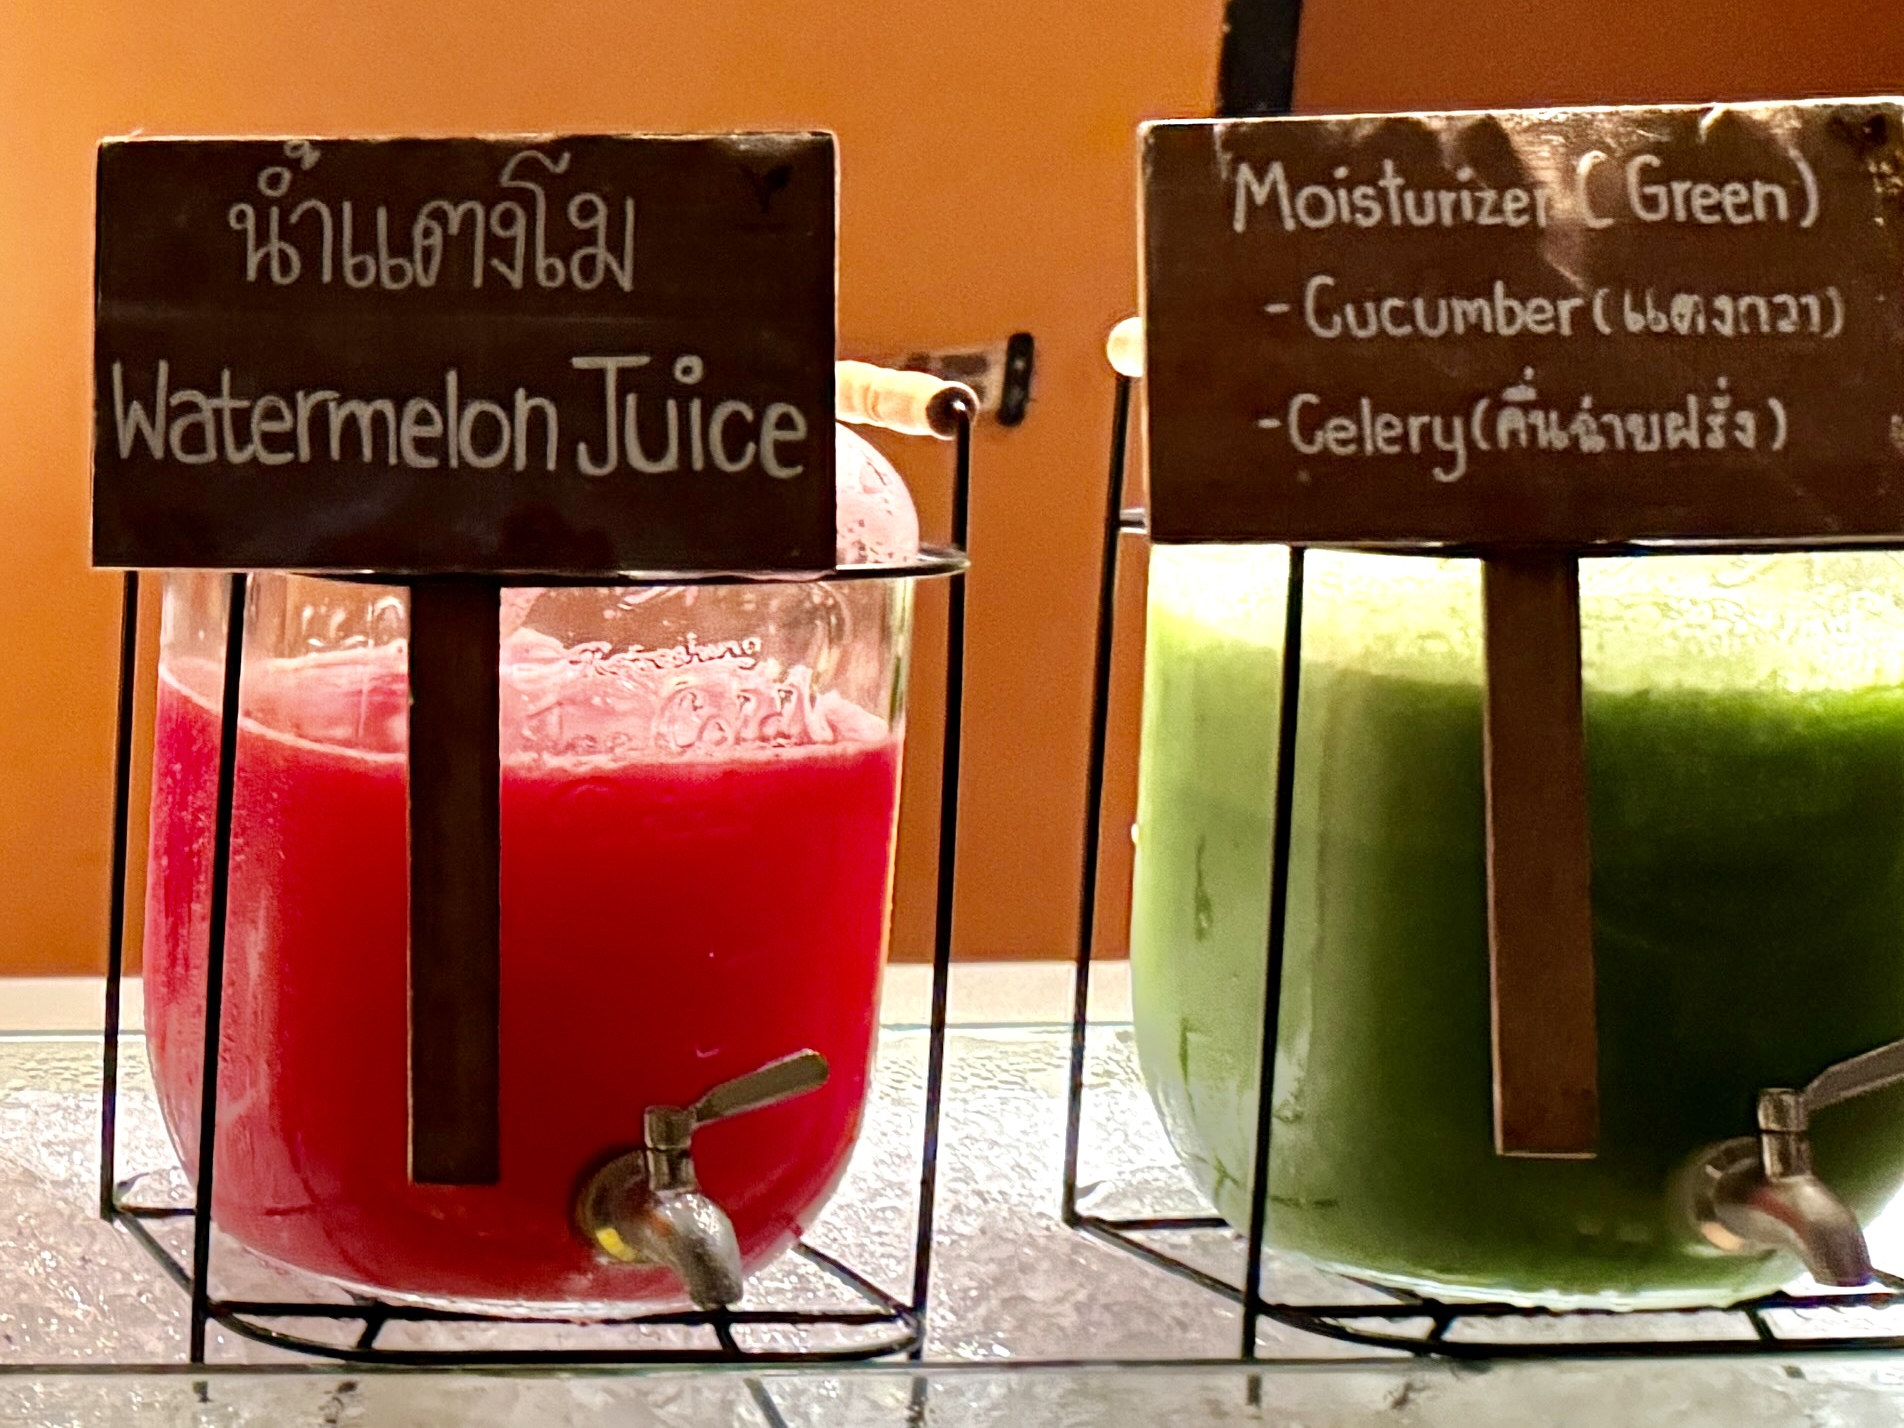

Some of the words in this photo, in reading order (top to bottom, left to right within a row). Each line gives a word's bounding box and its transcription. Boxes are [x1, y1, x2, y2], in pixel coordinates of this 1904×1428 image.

[228, 140, 636, 292] น้ำแตงโม
[1233, 157, 1554, 232] Moisturizer
[111, 359, 558, 472] Watermelon
[569, 353, 808, 479] Juice
